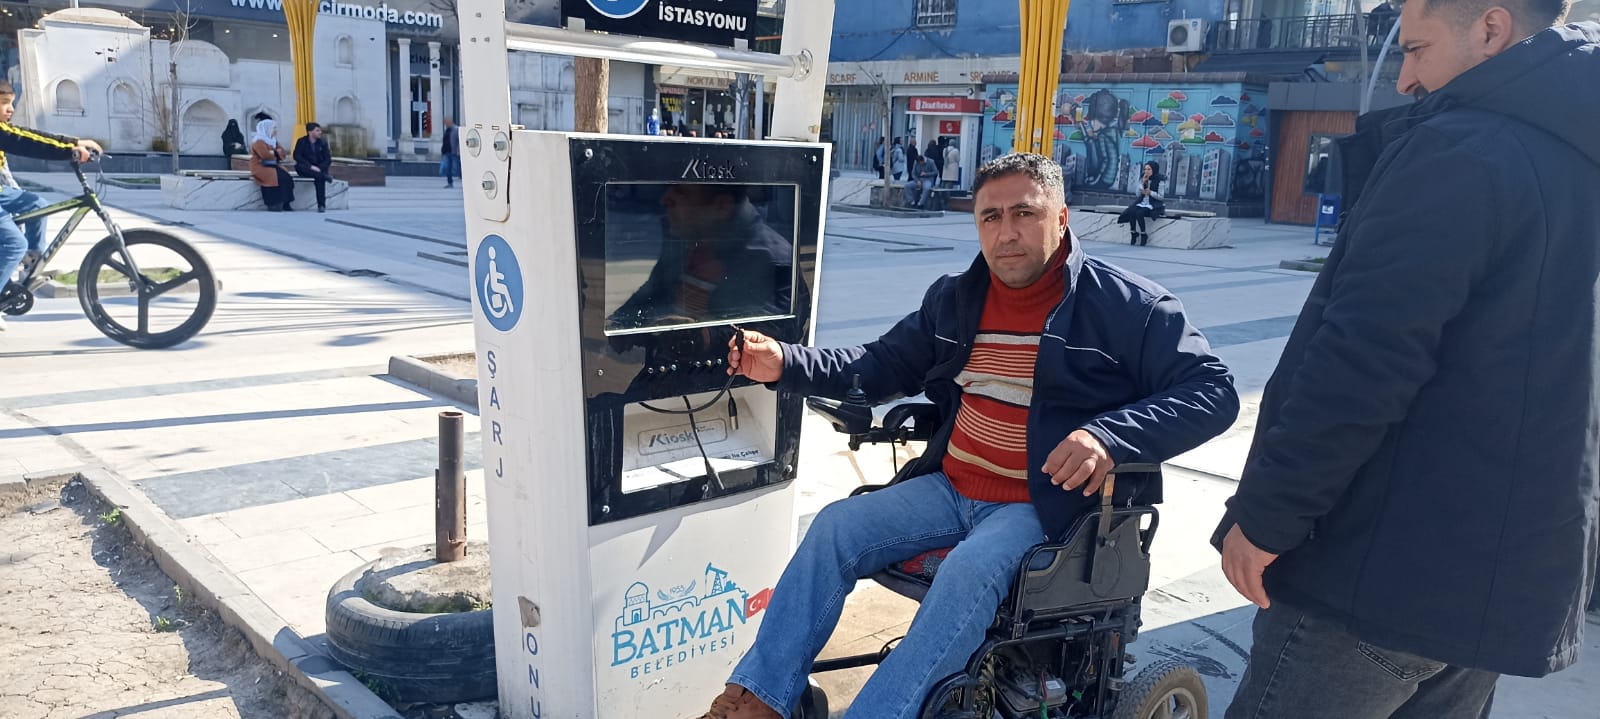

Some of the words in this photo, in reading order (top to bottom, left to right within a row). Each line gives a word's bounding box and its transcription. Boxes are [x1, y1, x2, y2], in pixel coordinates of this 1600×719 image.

[658, 1, 747, 31] İSTASYONU
[830, 73, 857, 83] SCARF
[681, 159, 736, 179] Kiosk
[487, 349, 504, 479] ŞARJ
[648, 429, 695, 448] Kiosk
[611, 594, 749, 667] BATMAN
[630, 631, 735, 679] BELEDİYESİ
